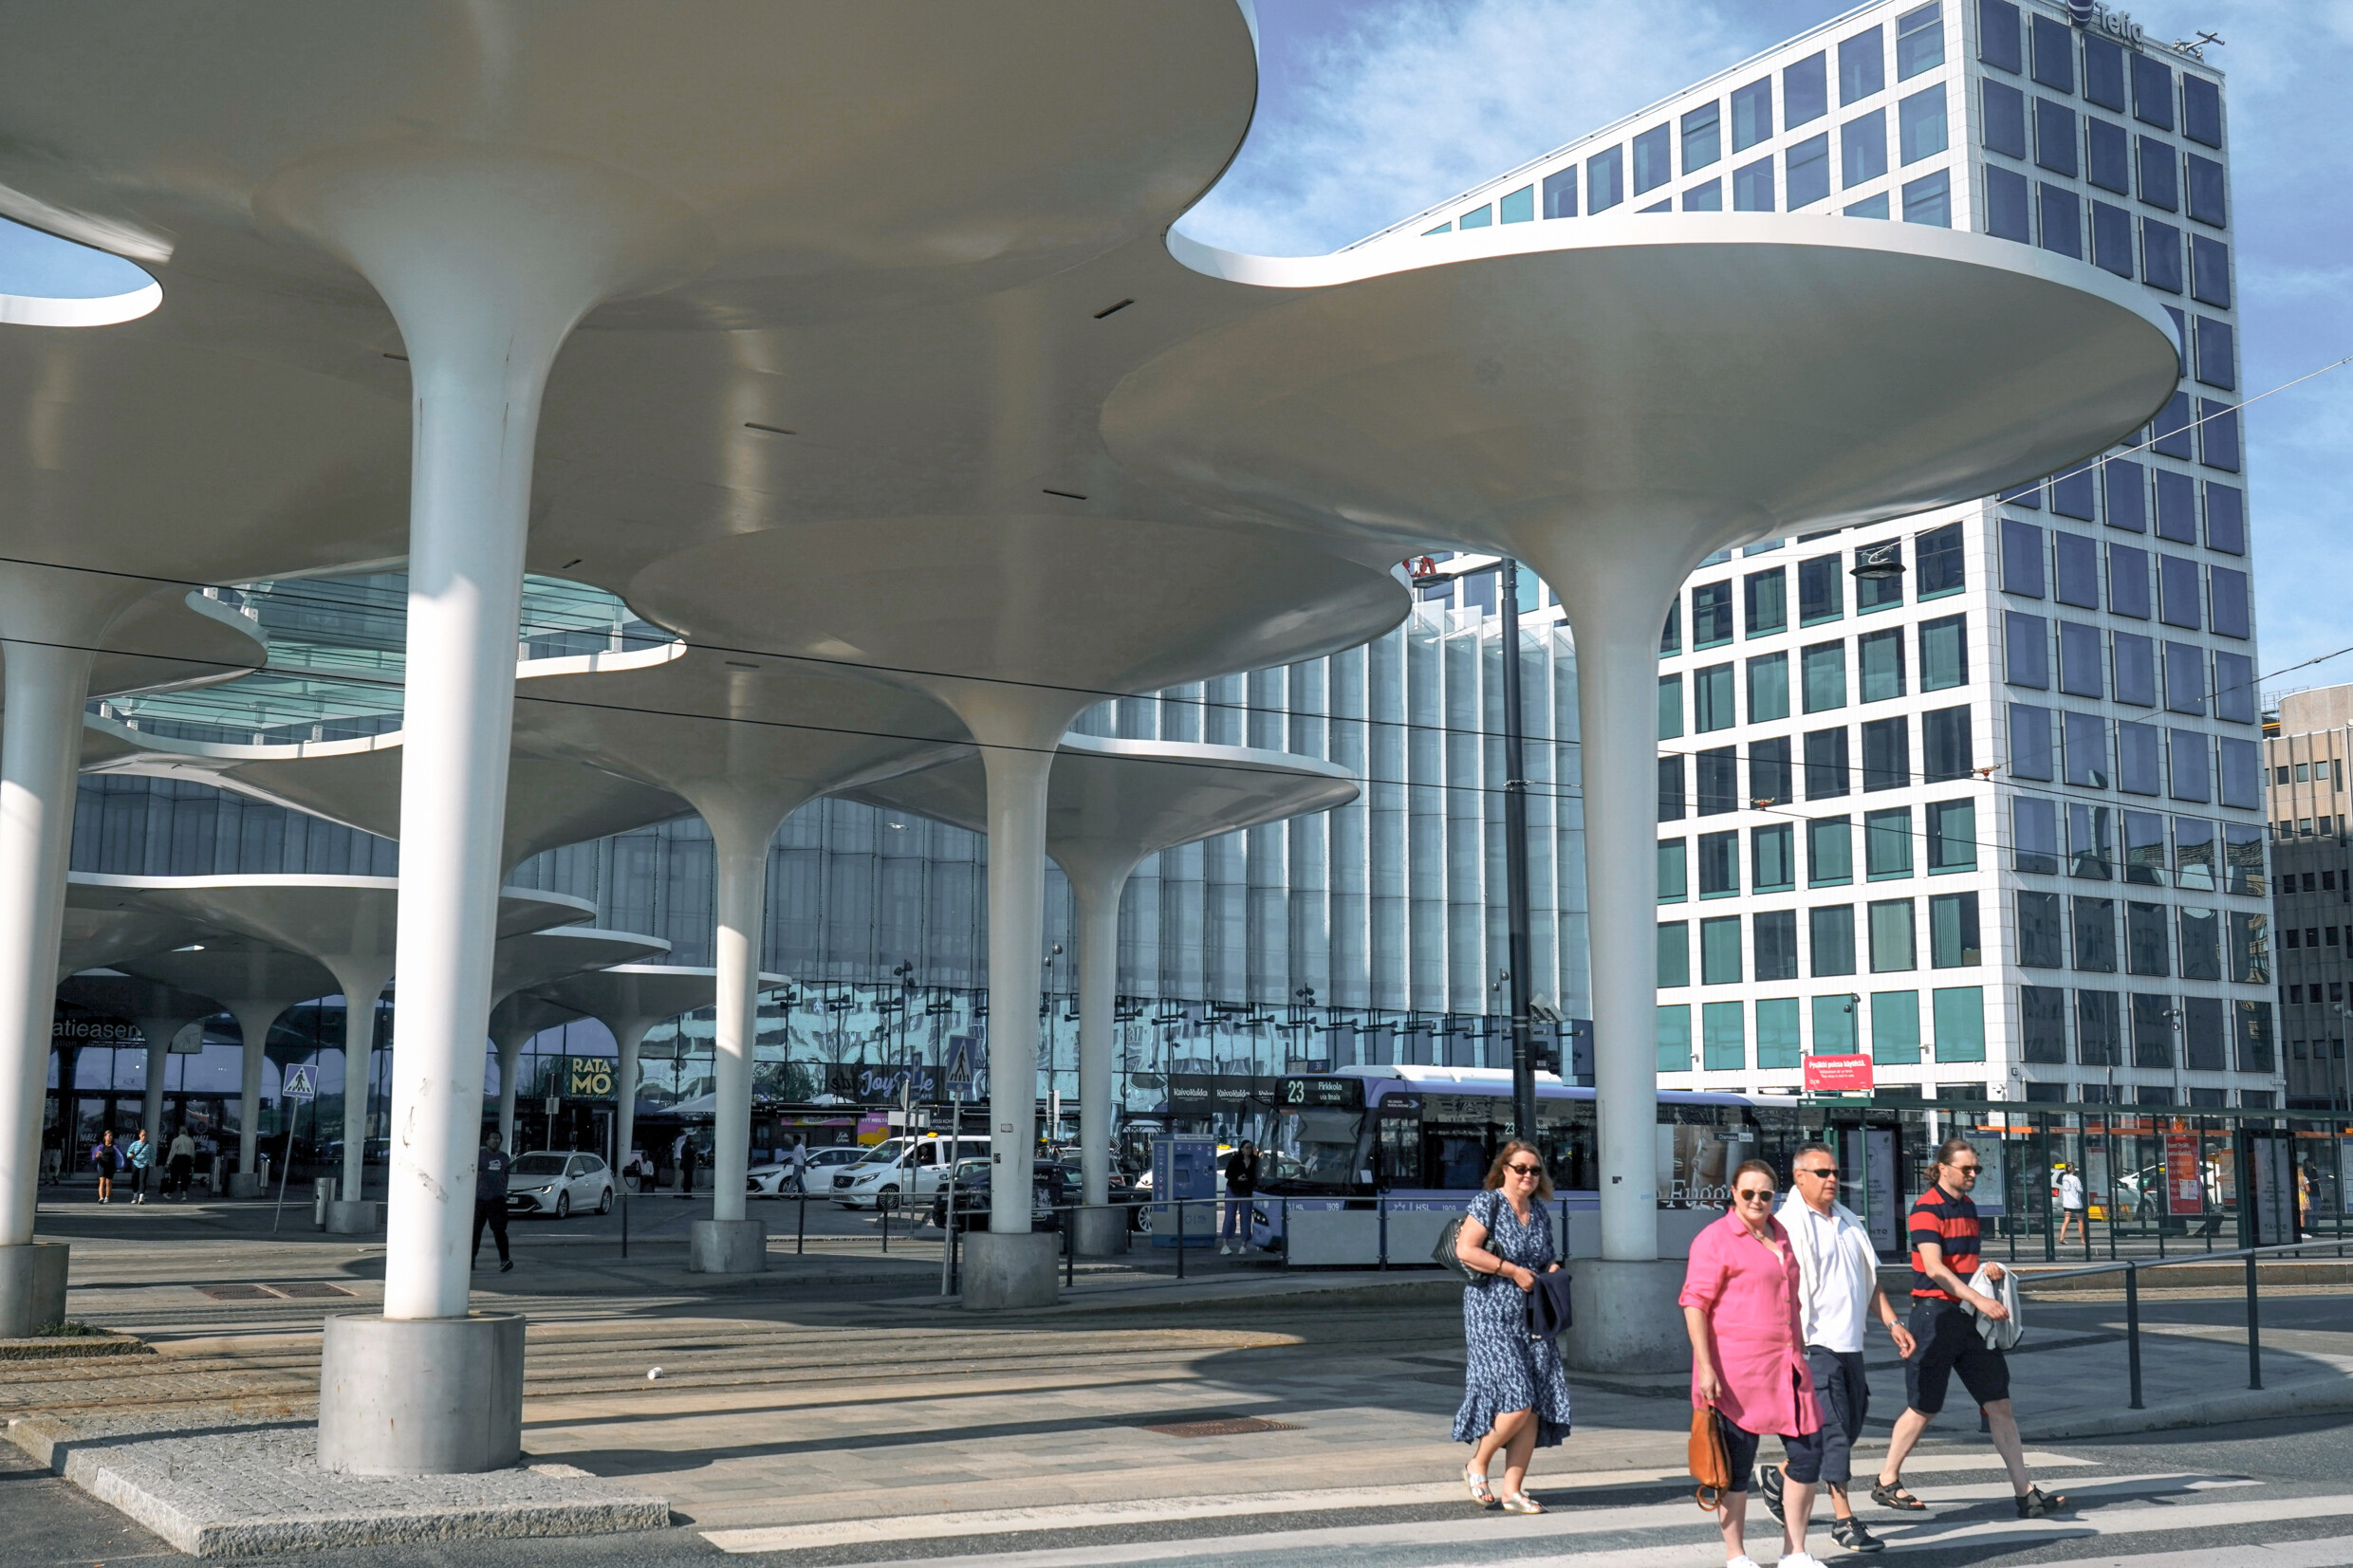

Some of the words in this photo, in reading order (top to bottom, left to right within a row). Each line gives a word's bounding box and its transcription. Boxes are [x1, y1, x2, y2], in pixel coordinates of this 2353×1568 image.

[2095, 2, 2144, 45] Telia
[572, 1058, 612, 1073] RATA
[571, 1073, 612, 1095] MO
[1288, 1080, 1305, 1103] 23
[1318, 1081, 1343, 1091] Pirkkola
[1505, 1122, 1515, 1134] 23
[1416, 1203, 1430, 1211] HSL
